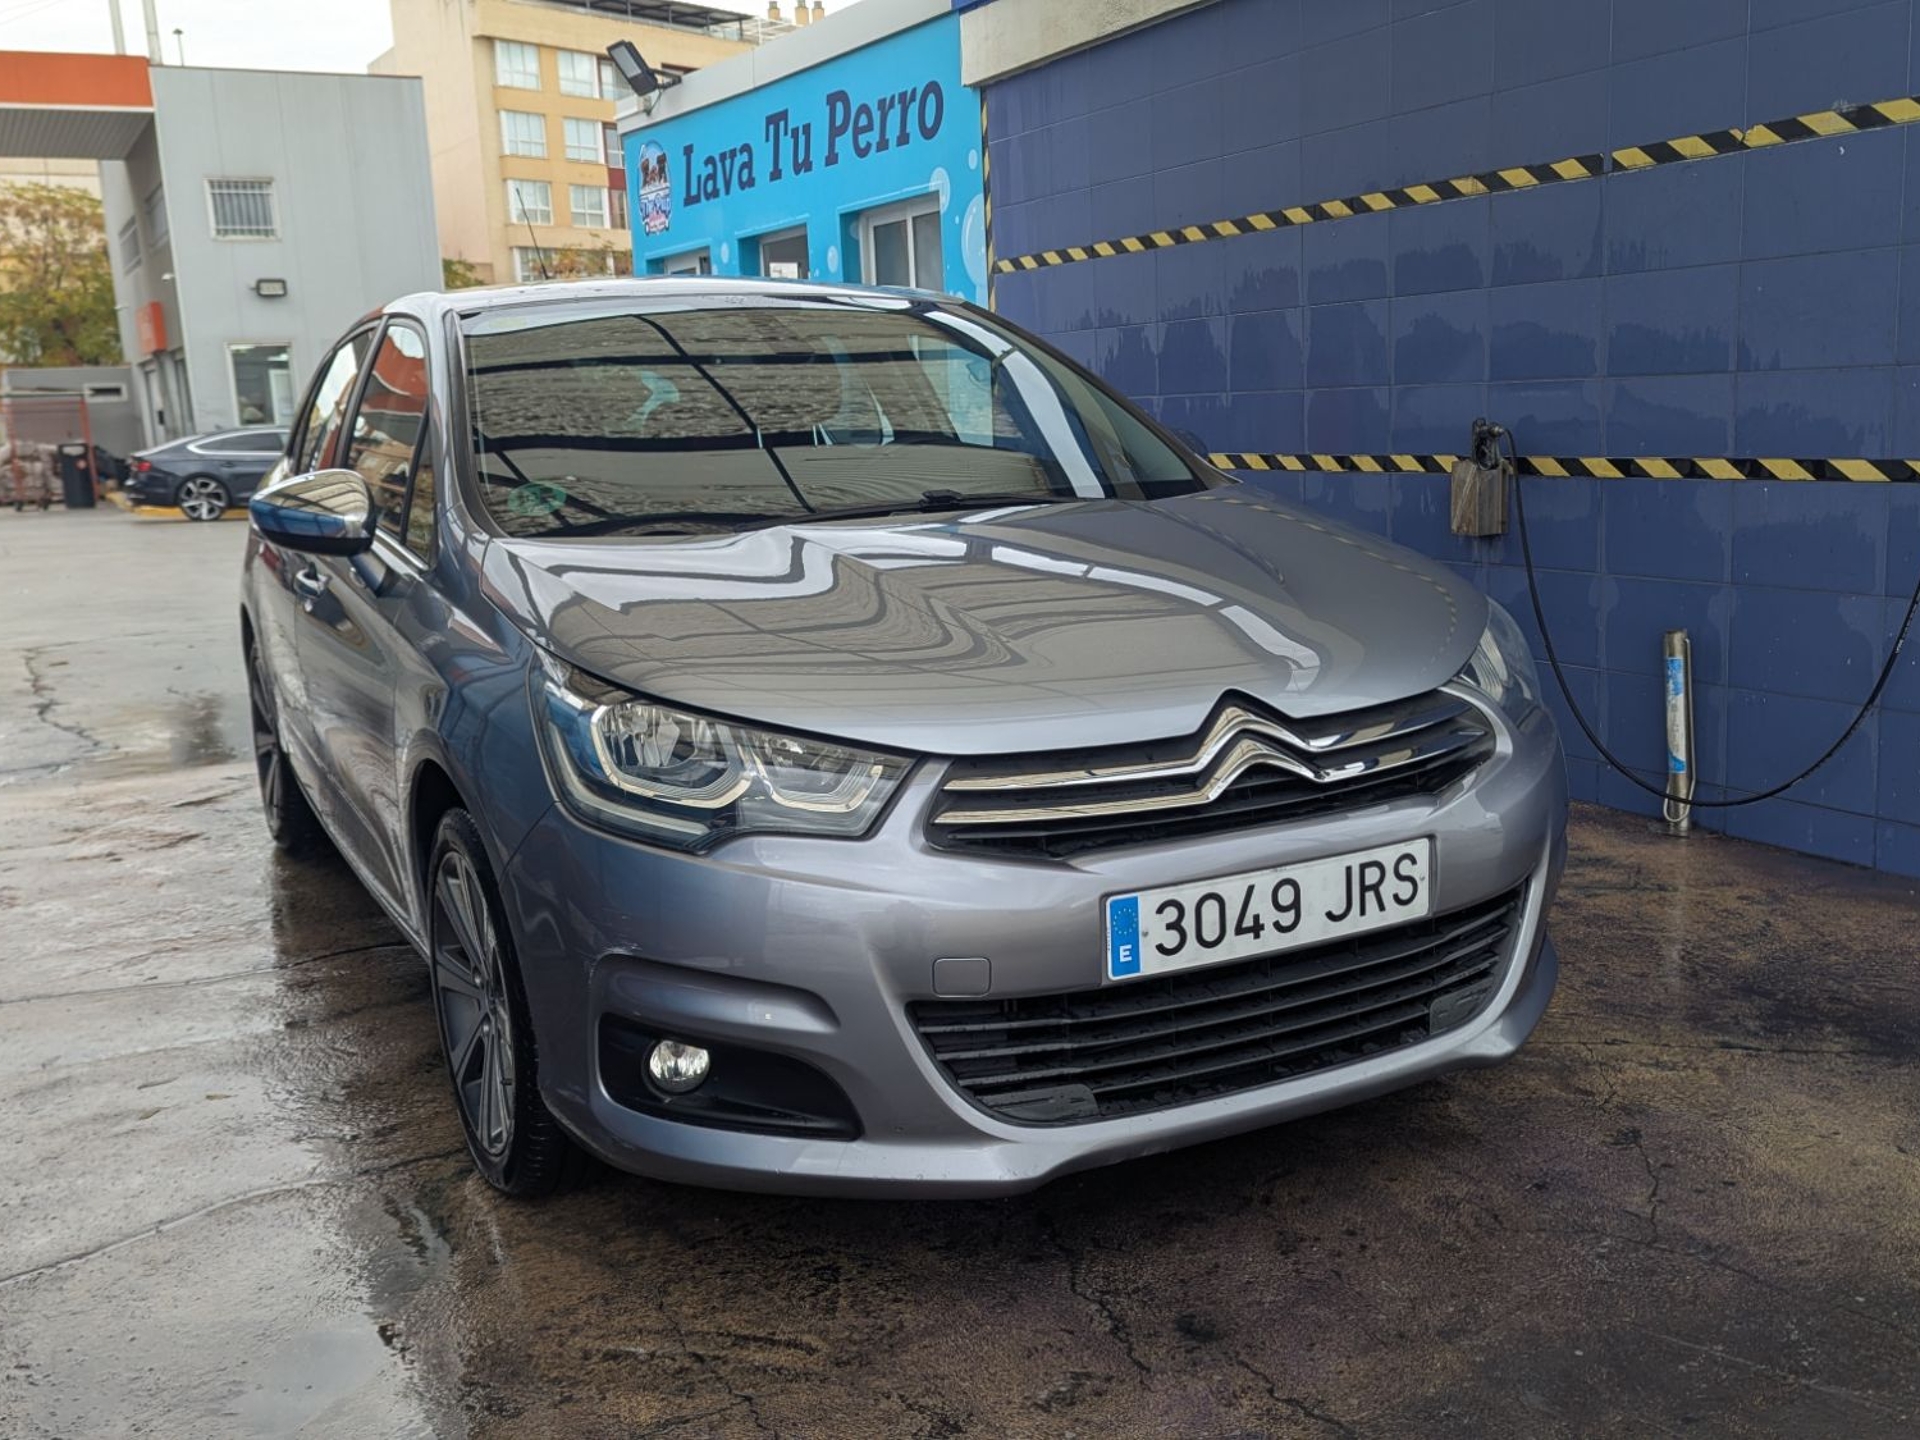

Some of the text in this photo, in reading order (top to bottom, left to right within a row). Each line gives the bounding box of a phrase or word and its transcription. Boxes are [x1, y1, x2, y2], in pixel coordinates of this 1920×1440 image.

[683, 81, 943, 206] Lava Tu Perro
[1119, 944, 1132, 963] E
[1155, 853, 1419, 956] 3049 JRS
